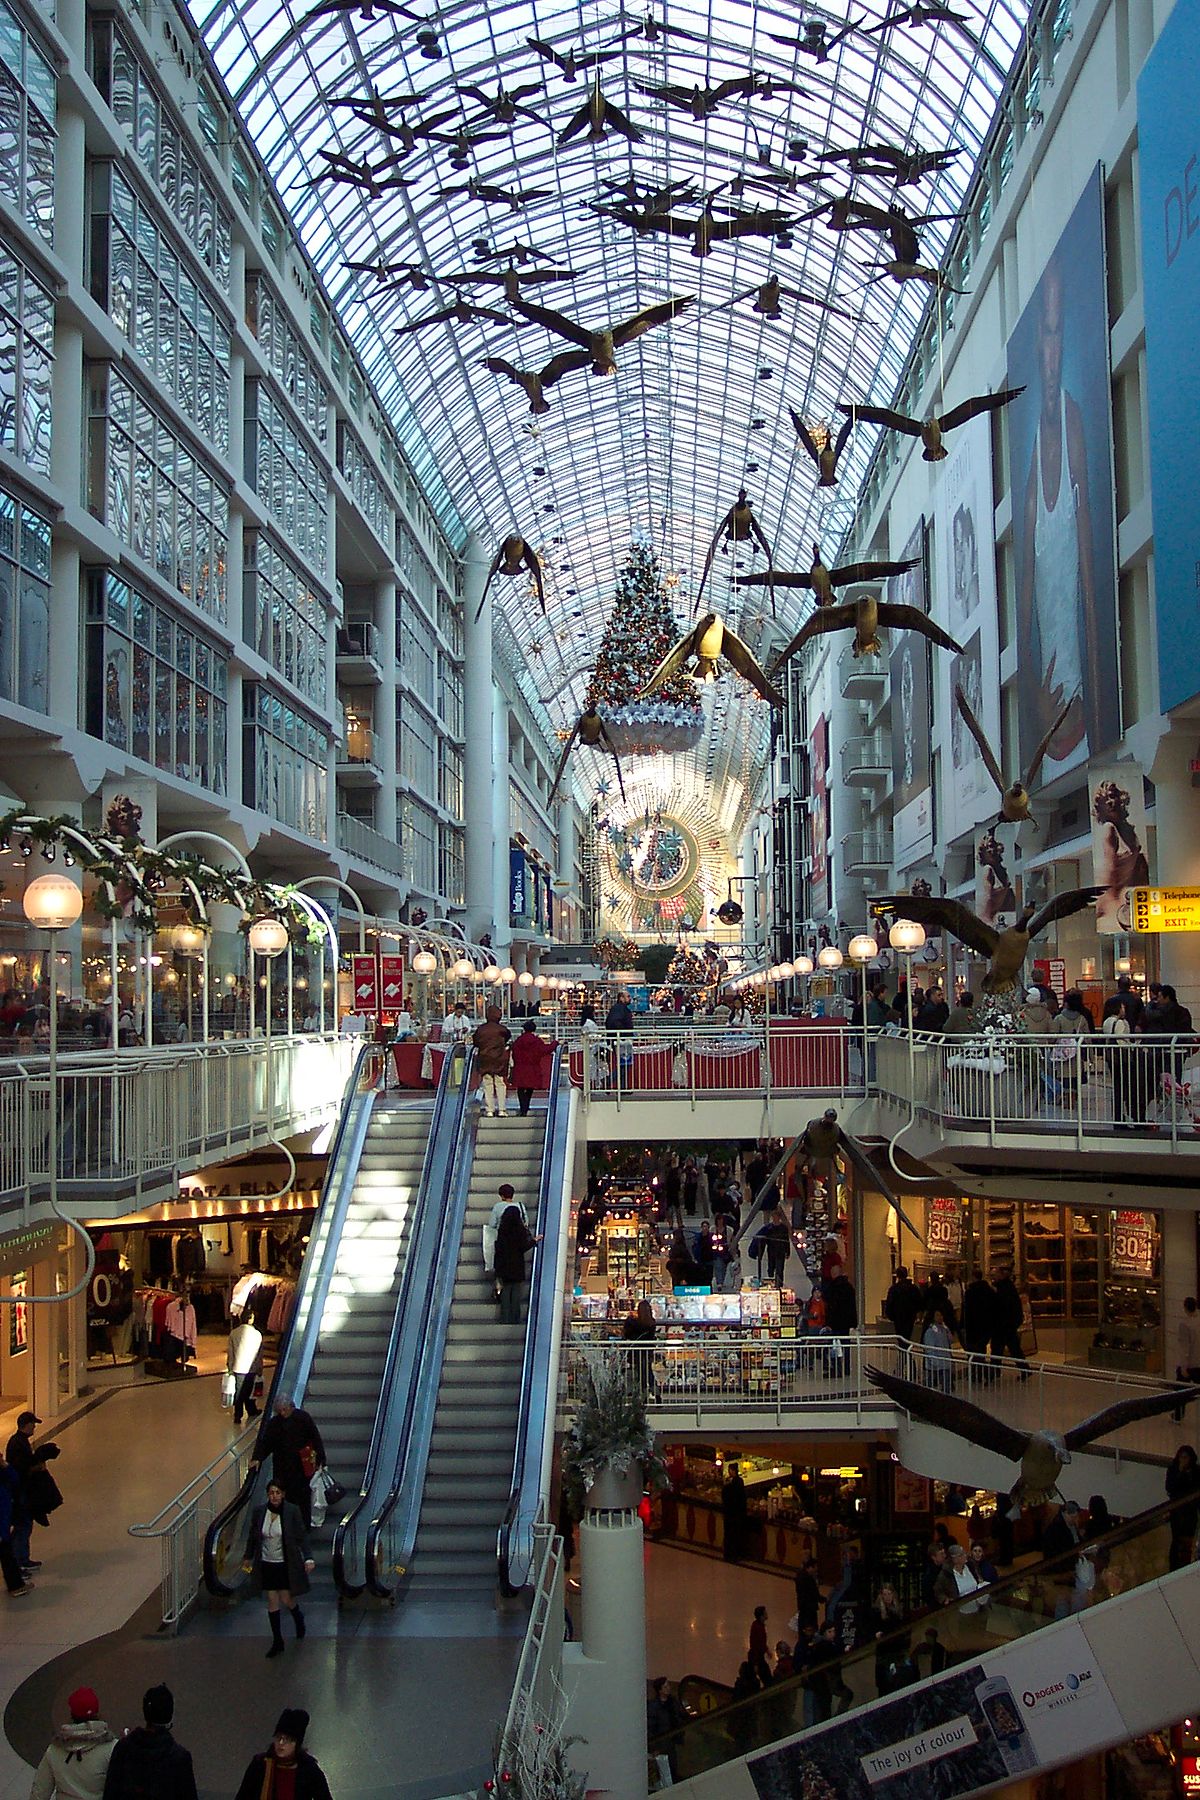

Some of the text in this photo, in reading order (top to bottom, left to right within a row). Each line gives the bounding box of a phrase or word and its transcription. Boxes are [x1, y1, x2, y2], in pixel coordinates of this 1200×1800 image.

[512, 870, 524, 913] Indigo Books
[1164, 905, 1194, 913] Lockers
[1164, 918, 1188, 927] EXIT
[1035, 1681, 1065, 1700] ROGERS
[704, 1694, 711, 1710] 1
[869, 1726, 966, 1772] The joy of colour
